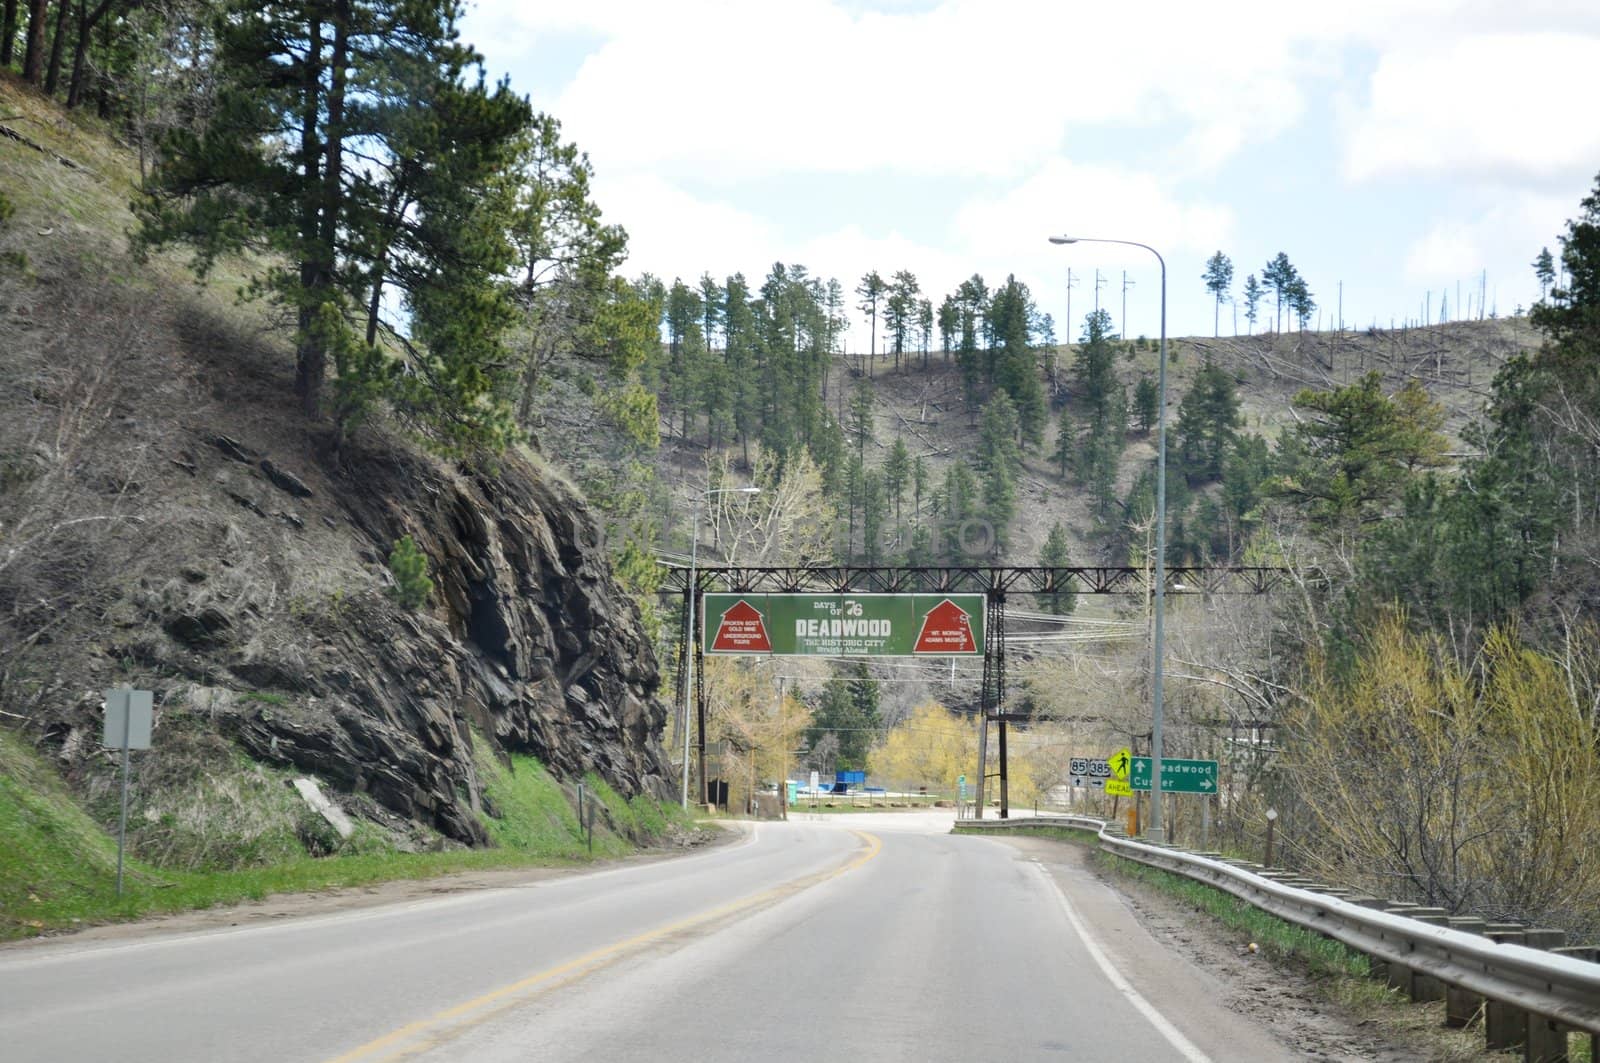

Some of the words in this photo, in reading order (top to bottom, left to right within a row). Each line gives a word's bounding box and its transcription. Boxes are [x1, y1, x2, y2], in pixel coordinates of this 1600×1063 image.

[813, 601, 836, 609] DAYS
[830, 608, 843, 616] OF
[795, 618, 892, 637] DEADWOOD
[804, 639, 821, 647] THE
[822, 639, 863, 647] HISTORIC
[864, 639, 886, 647] CITY
[1072, 760, 1086, 772] 85
[1091, 762, 1110, 774] 385
[1160, 765, 1212, 775] eadwood
[1134, 777, 1174, 787] Cuser
